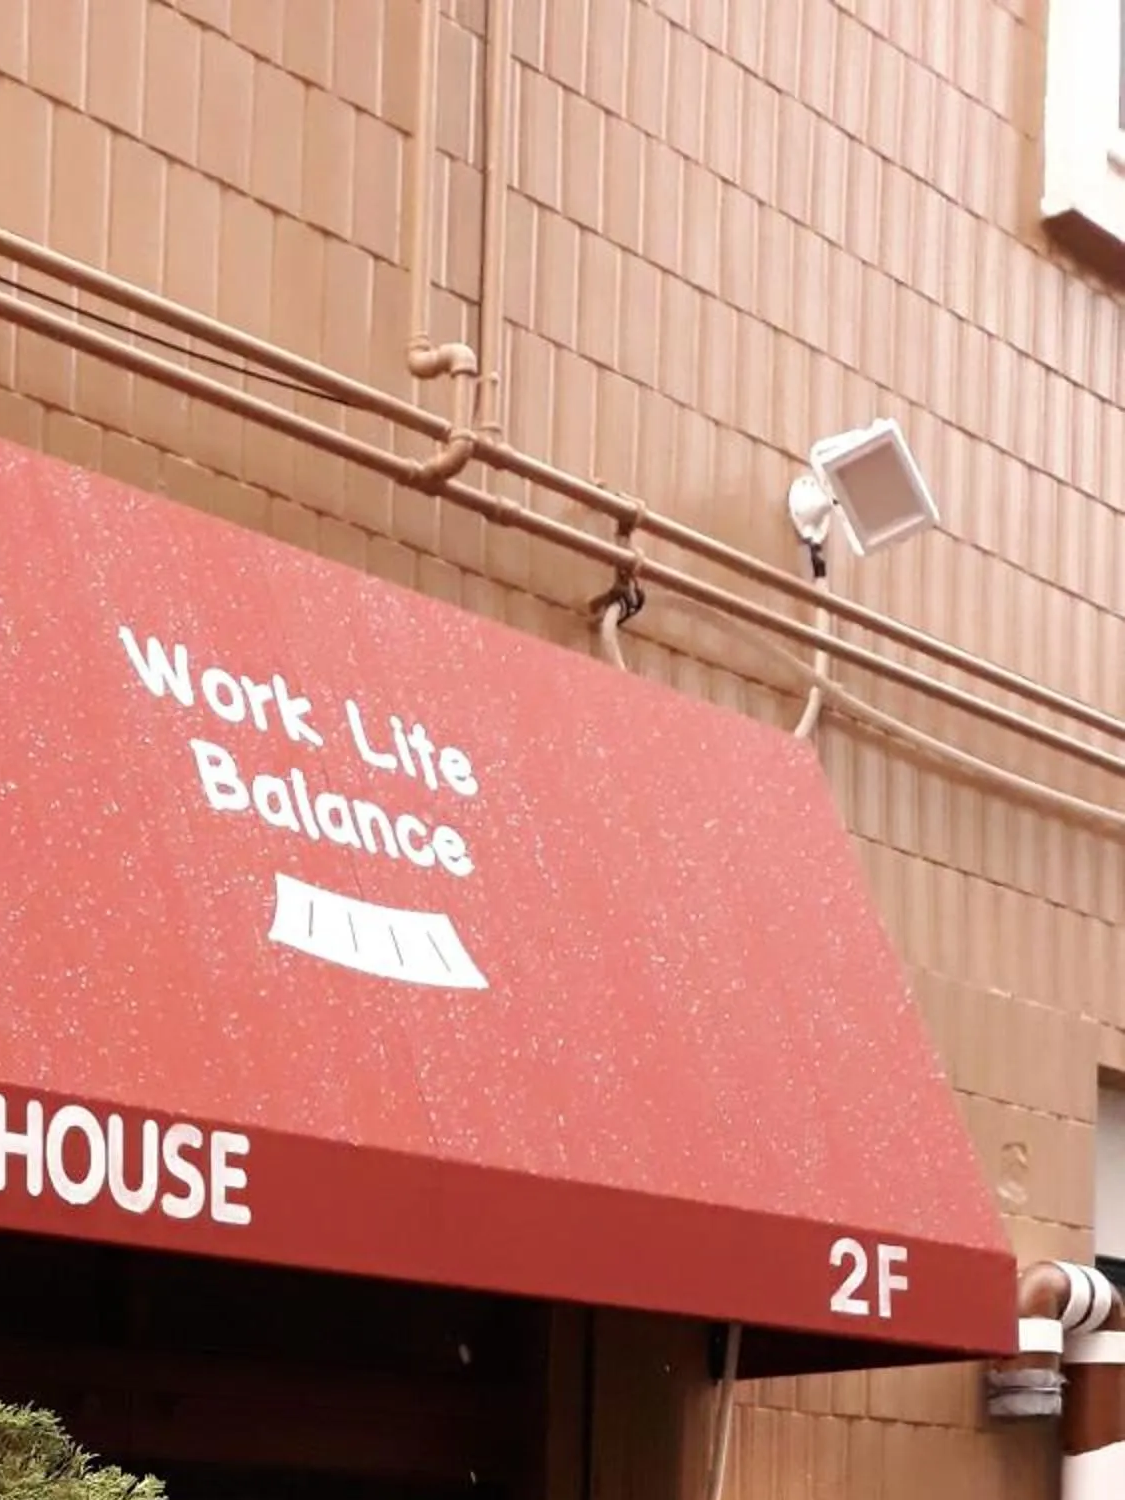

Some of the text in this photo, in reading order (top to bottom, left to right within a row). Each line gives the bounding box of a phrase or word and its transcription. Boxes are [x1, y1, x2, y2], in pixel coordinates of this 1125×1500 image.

[118, 625, 323, 746] Work
[189, 737, 475, 878] Balance
[829, 1236, 909, 1319] 2F
